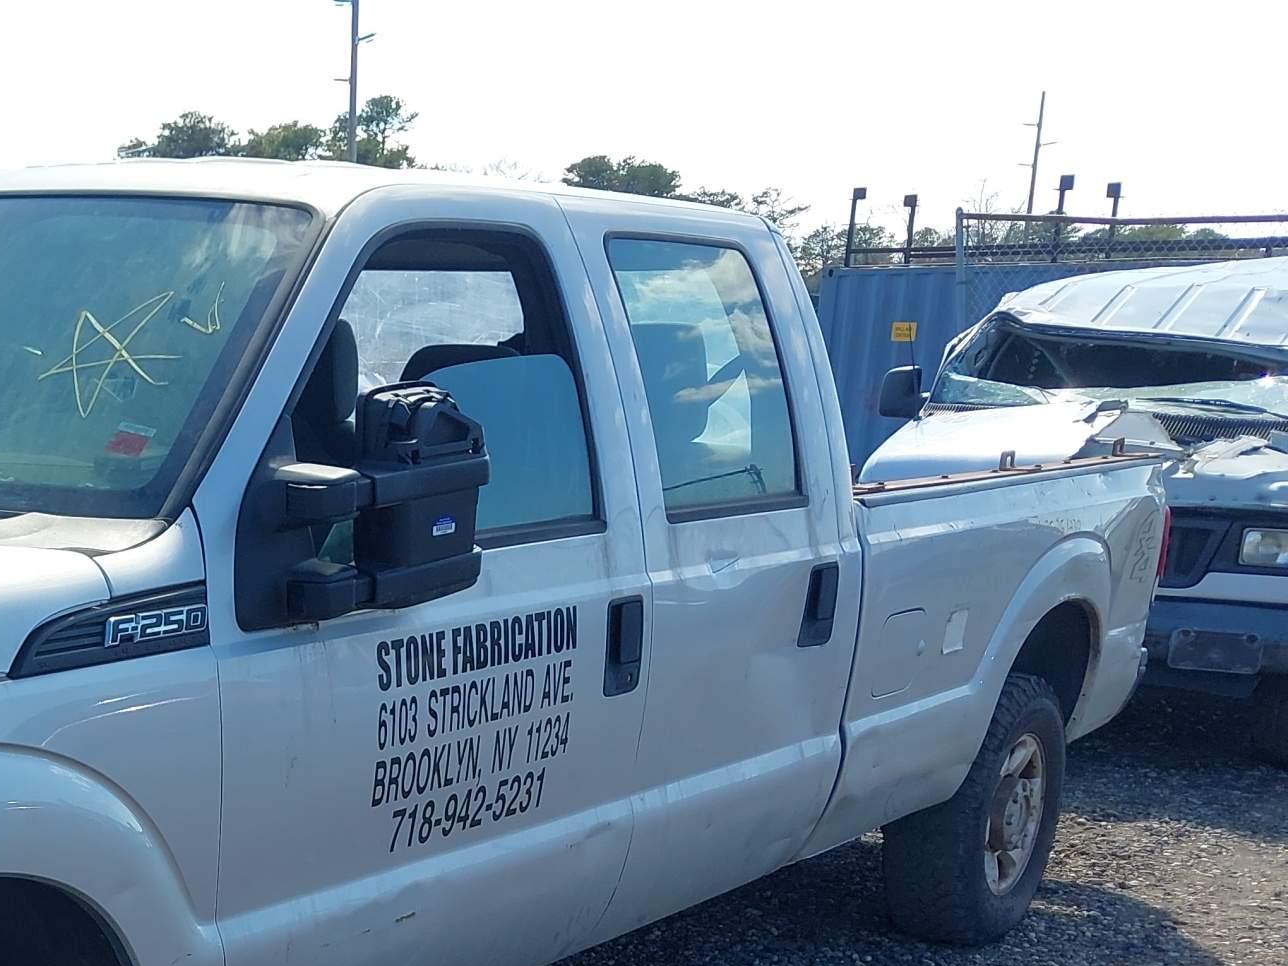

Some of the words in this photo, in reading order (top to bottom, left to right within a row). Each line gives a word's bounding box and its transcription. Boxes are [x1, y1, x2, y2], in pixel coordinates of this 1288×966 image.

[376, 630, 447, 692] STONE
[451, 605, 578, 675] FABRICATION
[377, 695, 418, 750] 6103
[427, 668, 535, 738] STRICKLAND
[540, 660, 574, 709] AVE.
[491, 725, 520, 774] NY
[526, 712, 570, 765] 11234
[389, 767, 546, 853] 718-942-5231
